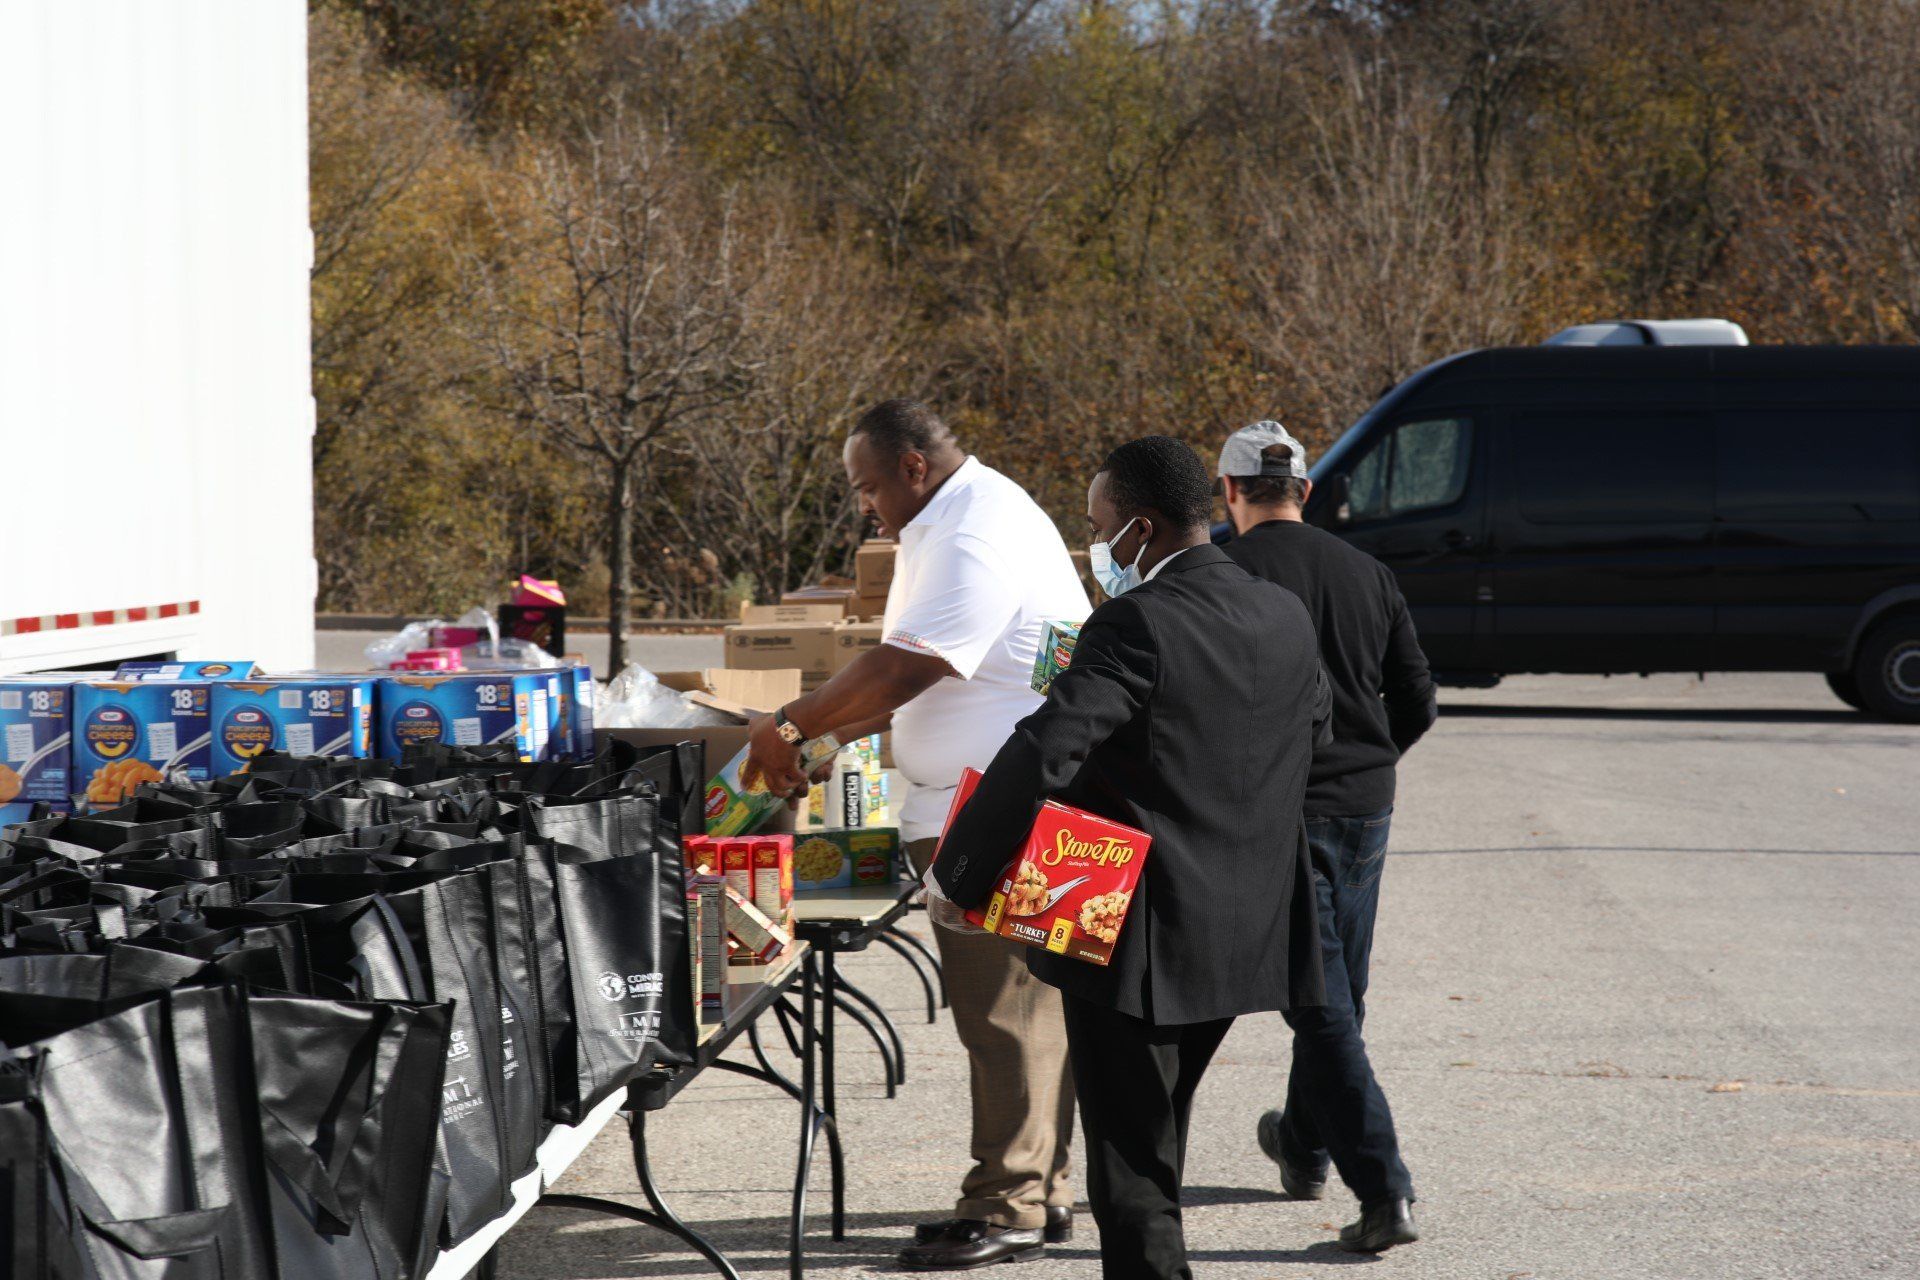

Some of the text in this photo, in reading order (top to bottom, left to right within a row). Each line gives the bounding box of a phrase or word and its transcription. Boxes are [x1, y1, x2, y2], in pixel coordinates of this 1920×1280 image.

[28, 690, 50, 711] 18
[171, 689, 193, 709] 18
[309, 690, 331, 710] 18
[476, 685, 498, 704] 18
[991, 903, 999, 917] 8
[1015, 923, 1048, 939] TURKEY
[1055, 927, 1065, 940] 8
